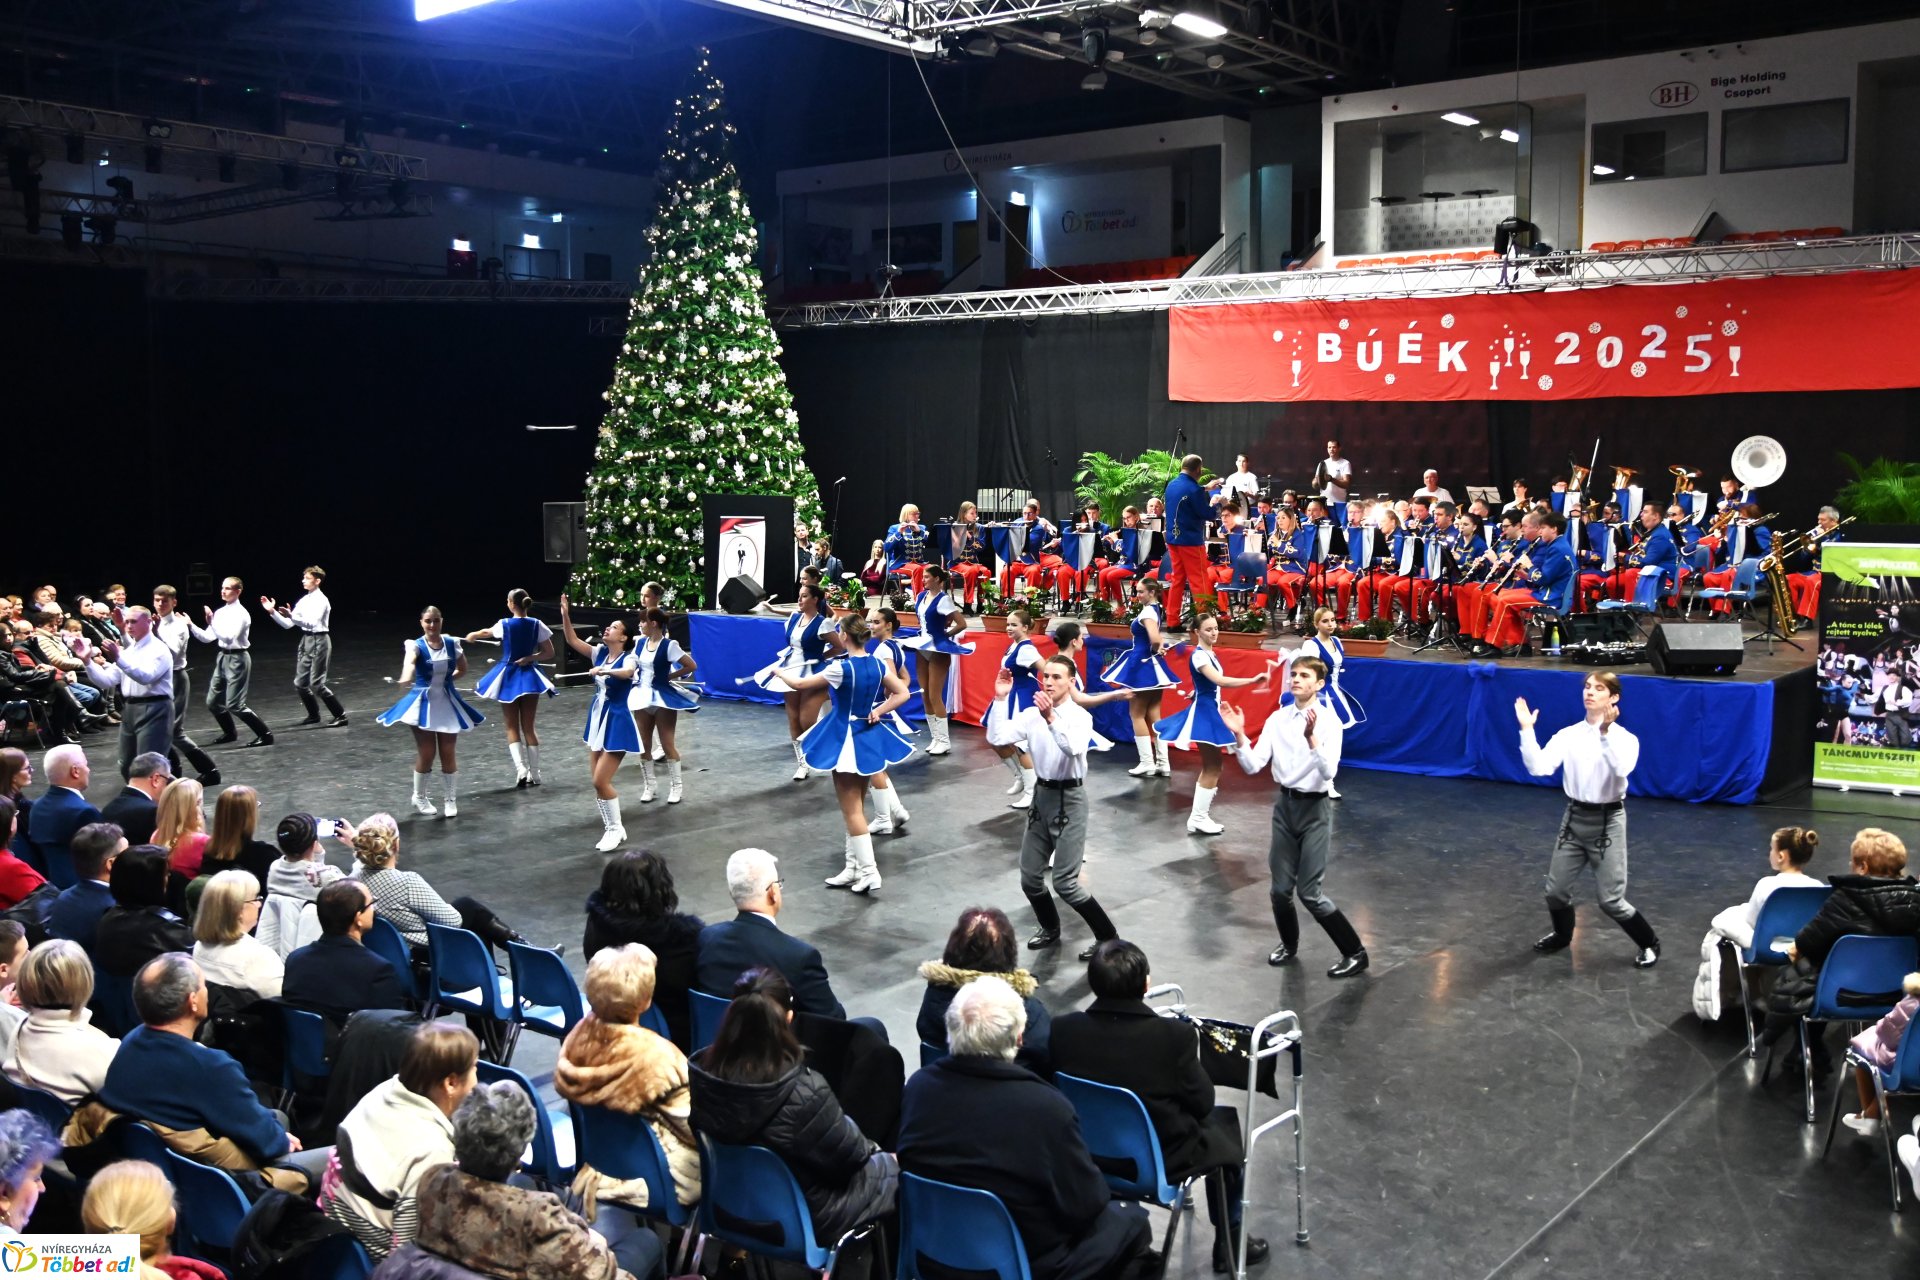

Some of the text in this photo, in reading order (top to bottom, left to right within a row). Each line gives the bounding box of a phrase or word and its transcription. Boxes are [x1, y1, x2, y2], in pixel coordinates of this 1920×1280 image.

[1710, 70, 1787, 88] Bige Holding
[1660, 85, 1690, 105] BH
[1724, 86, 1772, 99] Csoport
[1317, 320, 1713, 373] BÚÉK 2025
[1826, 628, 1851, 637] rejtett
